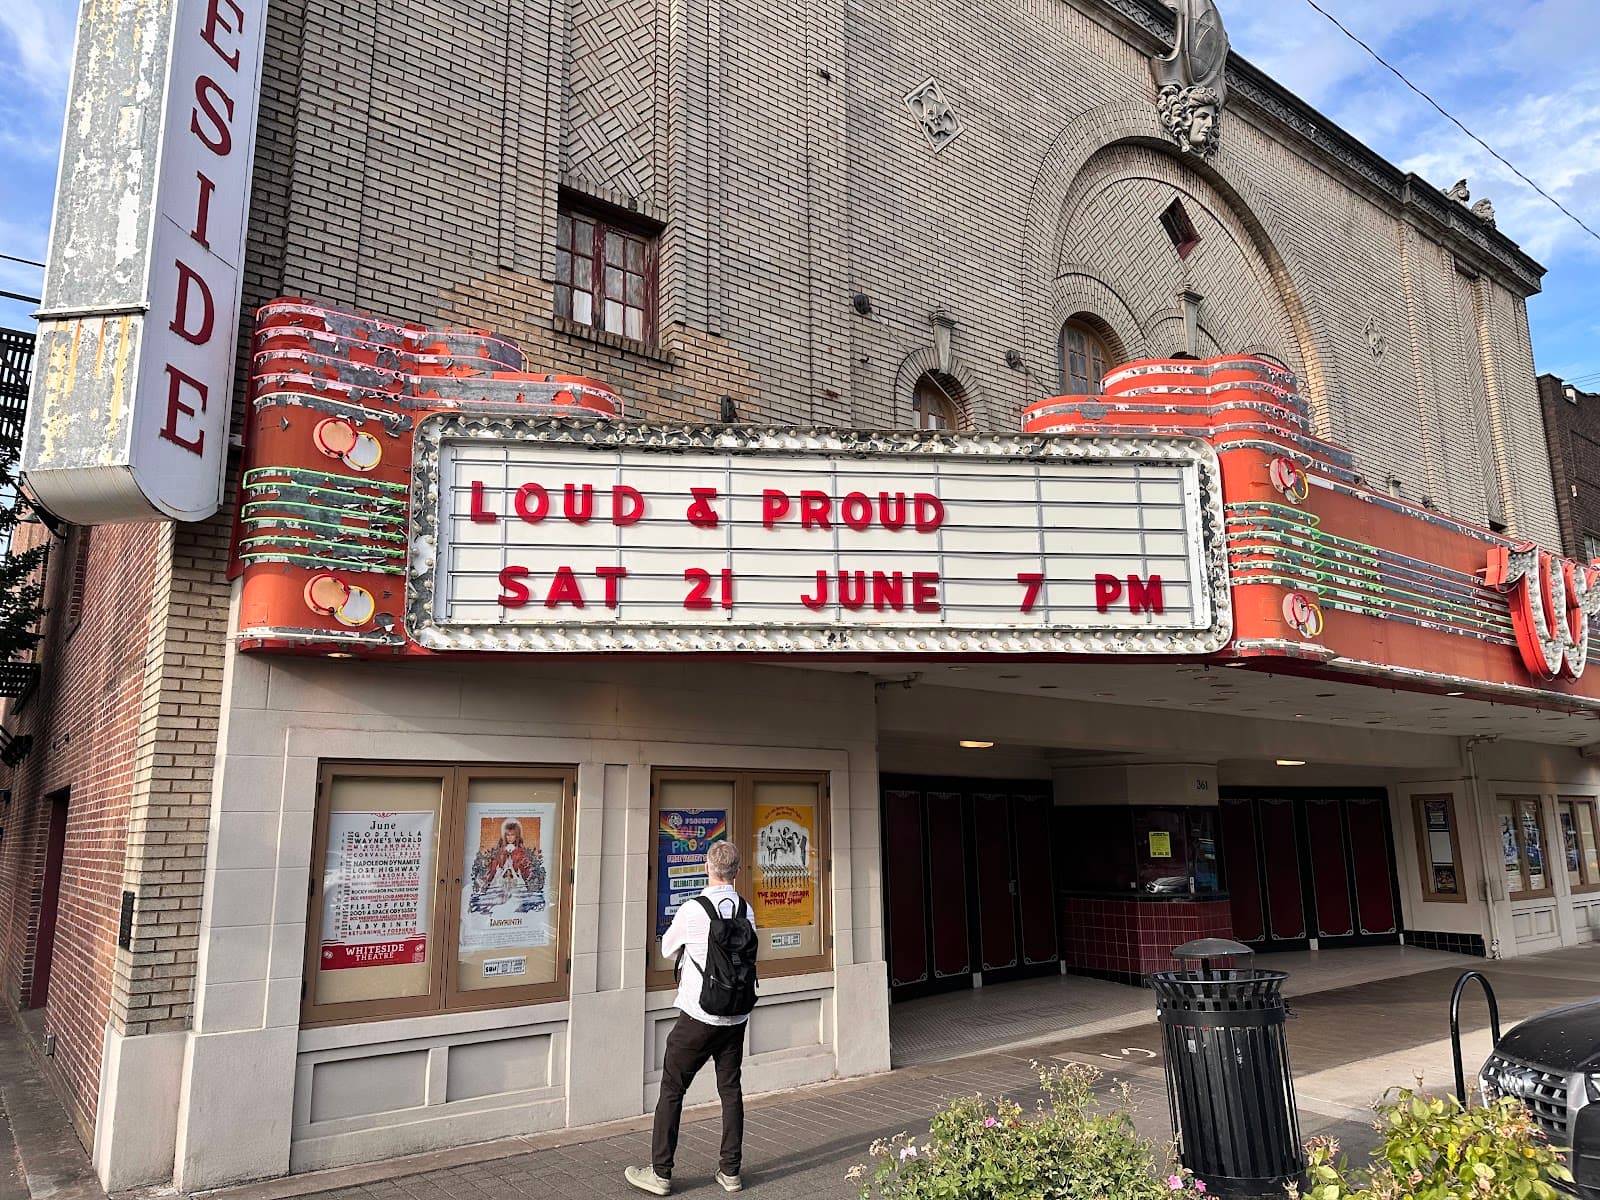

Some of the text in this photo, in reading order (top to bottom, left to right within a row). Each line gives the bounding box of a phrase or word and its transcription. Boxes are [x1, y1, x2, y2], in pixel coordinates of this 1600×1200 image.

[470, 480, 945, 532] LOUD & PROUD
[497, 565, 1164, 616] SAT 21 JUNE 7 PM
[370, 820, 396, 830] June
[770, 891, 788, 899] ROCKY
[348, 921, 416, 930] LABYRINTH
[346, 944, 404, 956] WHITESIDE
[356, 952, 394, 961] THEATRE
